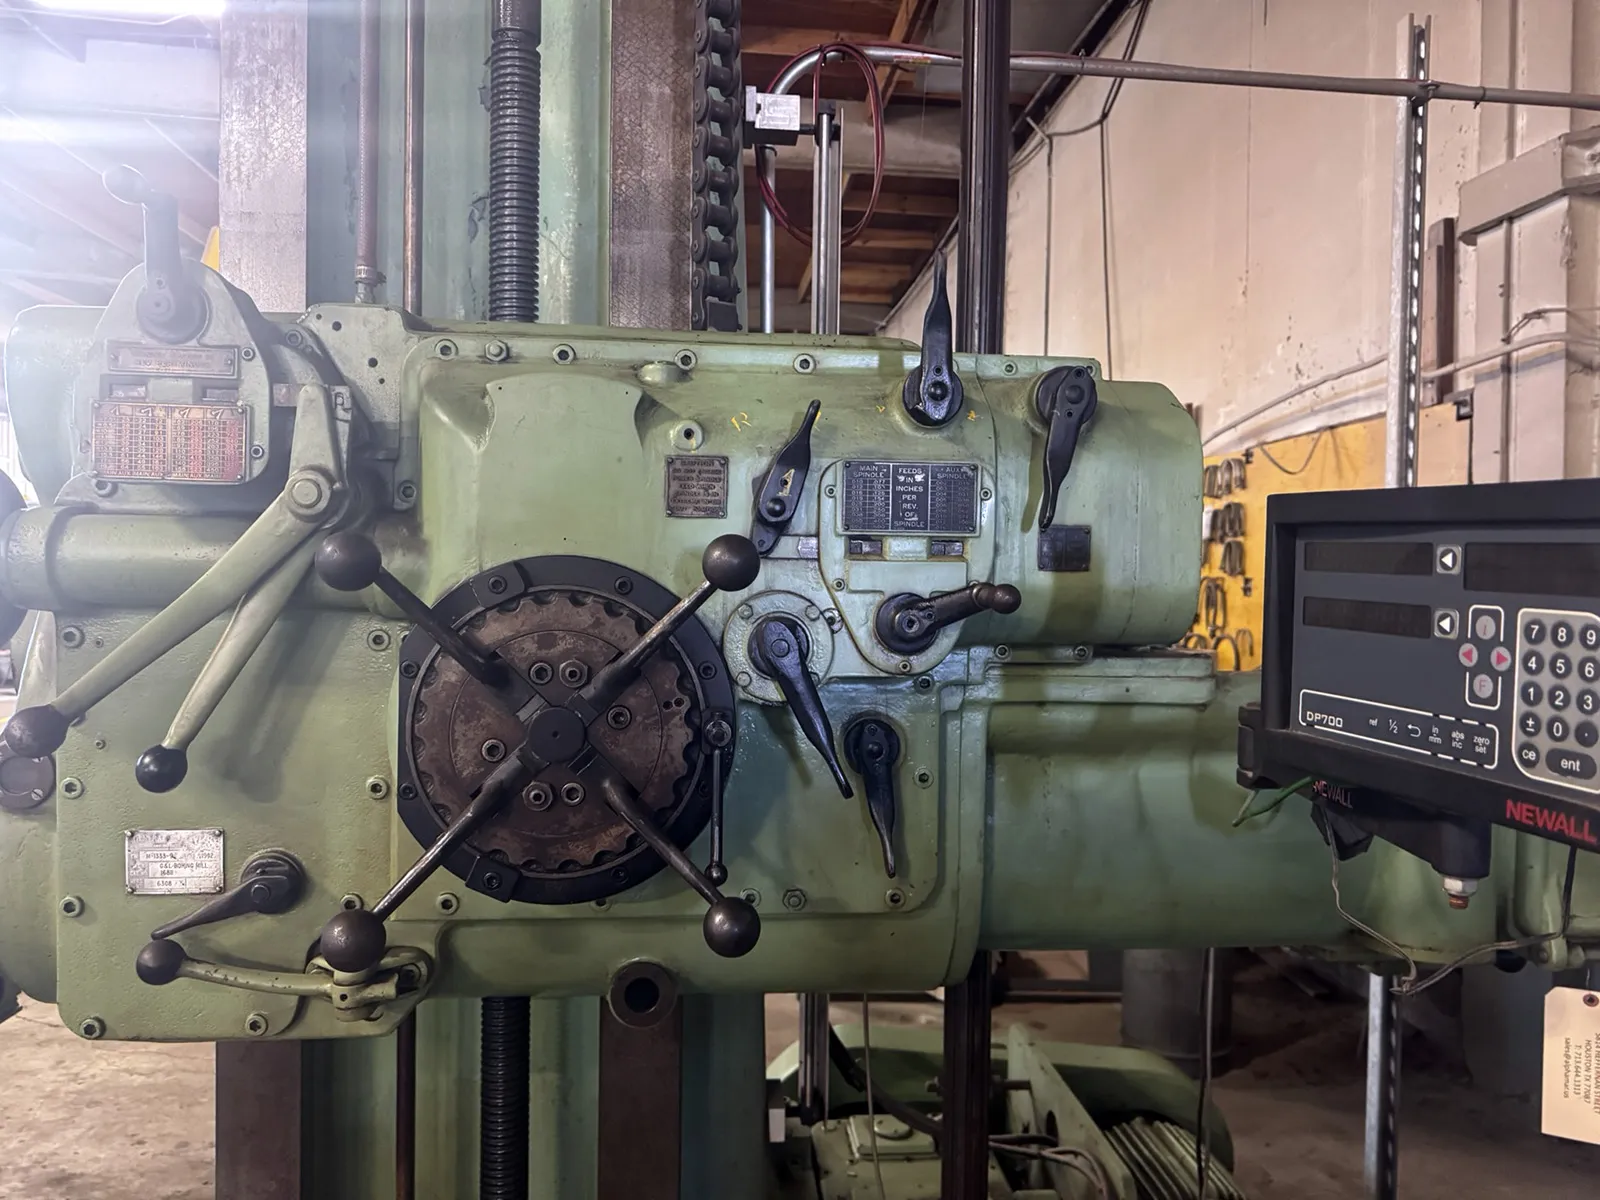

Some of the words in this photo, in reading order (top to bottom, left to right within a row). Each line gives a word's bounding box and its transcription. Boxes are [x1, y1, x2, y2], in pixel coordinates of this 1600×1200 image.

[1530, 625, 1539, 639] 7
[1557, 627, 1567, 642] 8
[1586, 630, 1596, 645] 9
[1528, 656, 1537, 670] 4
[1556, 659, 1565, 674] 5
[1584, 662, 1595, 677] 6
[1479, 678, 1488, 692] F
[1528, 687, 1534, 700] 1
[1555, 691, 1564, 706] 2
[1583, 695, 1593, 710] 3
[1306, 710, 1343, 728] DP700
[1369, 718, 1378, 726] ref
[1432, 725, 1439, 734] in
[1451, 730, 1465, 740] abs
[1553, 722, 1562, 736] 0
[1428, 735, 1442, 744] mm
[1452, 740, 1463, 749] inc
[1473, 735, 1490, 745] zero
[1475, 745, 1486, 754] set
[1522, 749, 1536, 758] ce
[1561, 759, 1580, 772] ent
[1313, 780, 1353, 809] NEWALL
[1506, 798, 1598, 845] NEWALL
